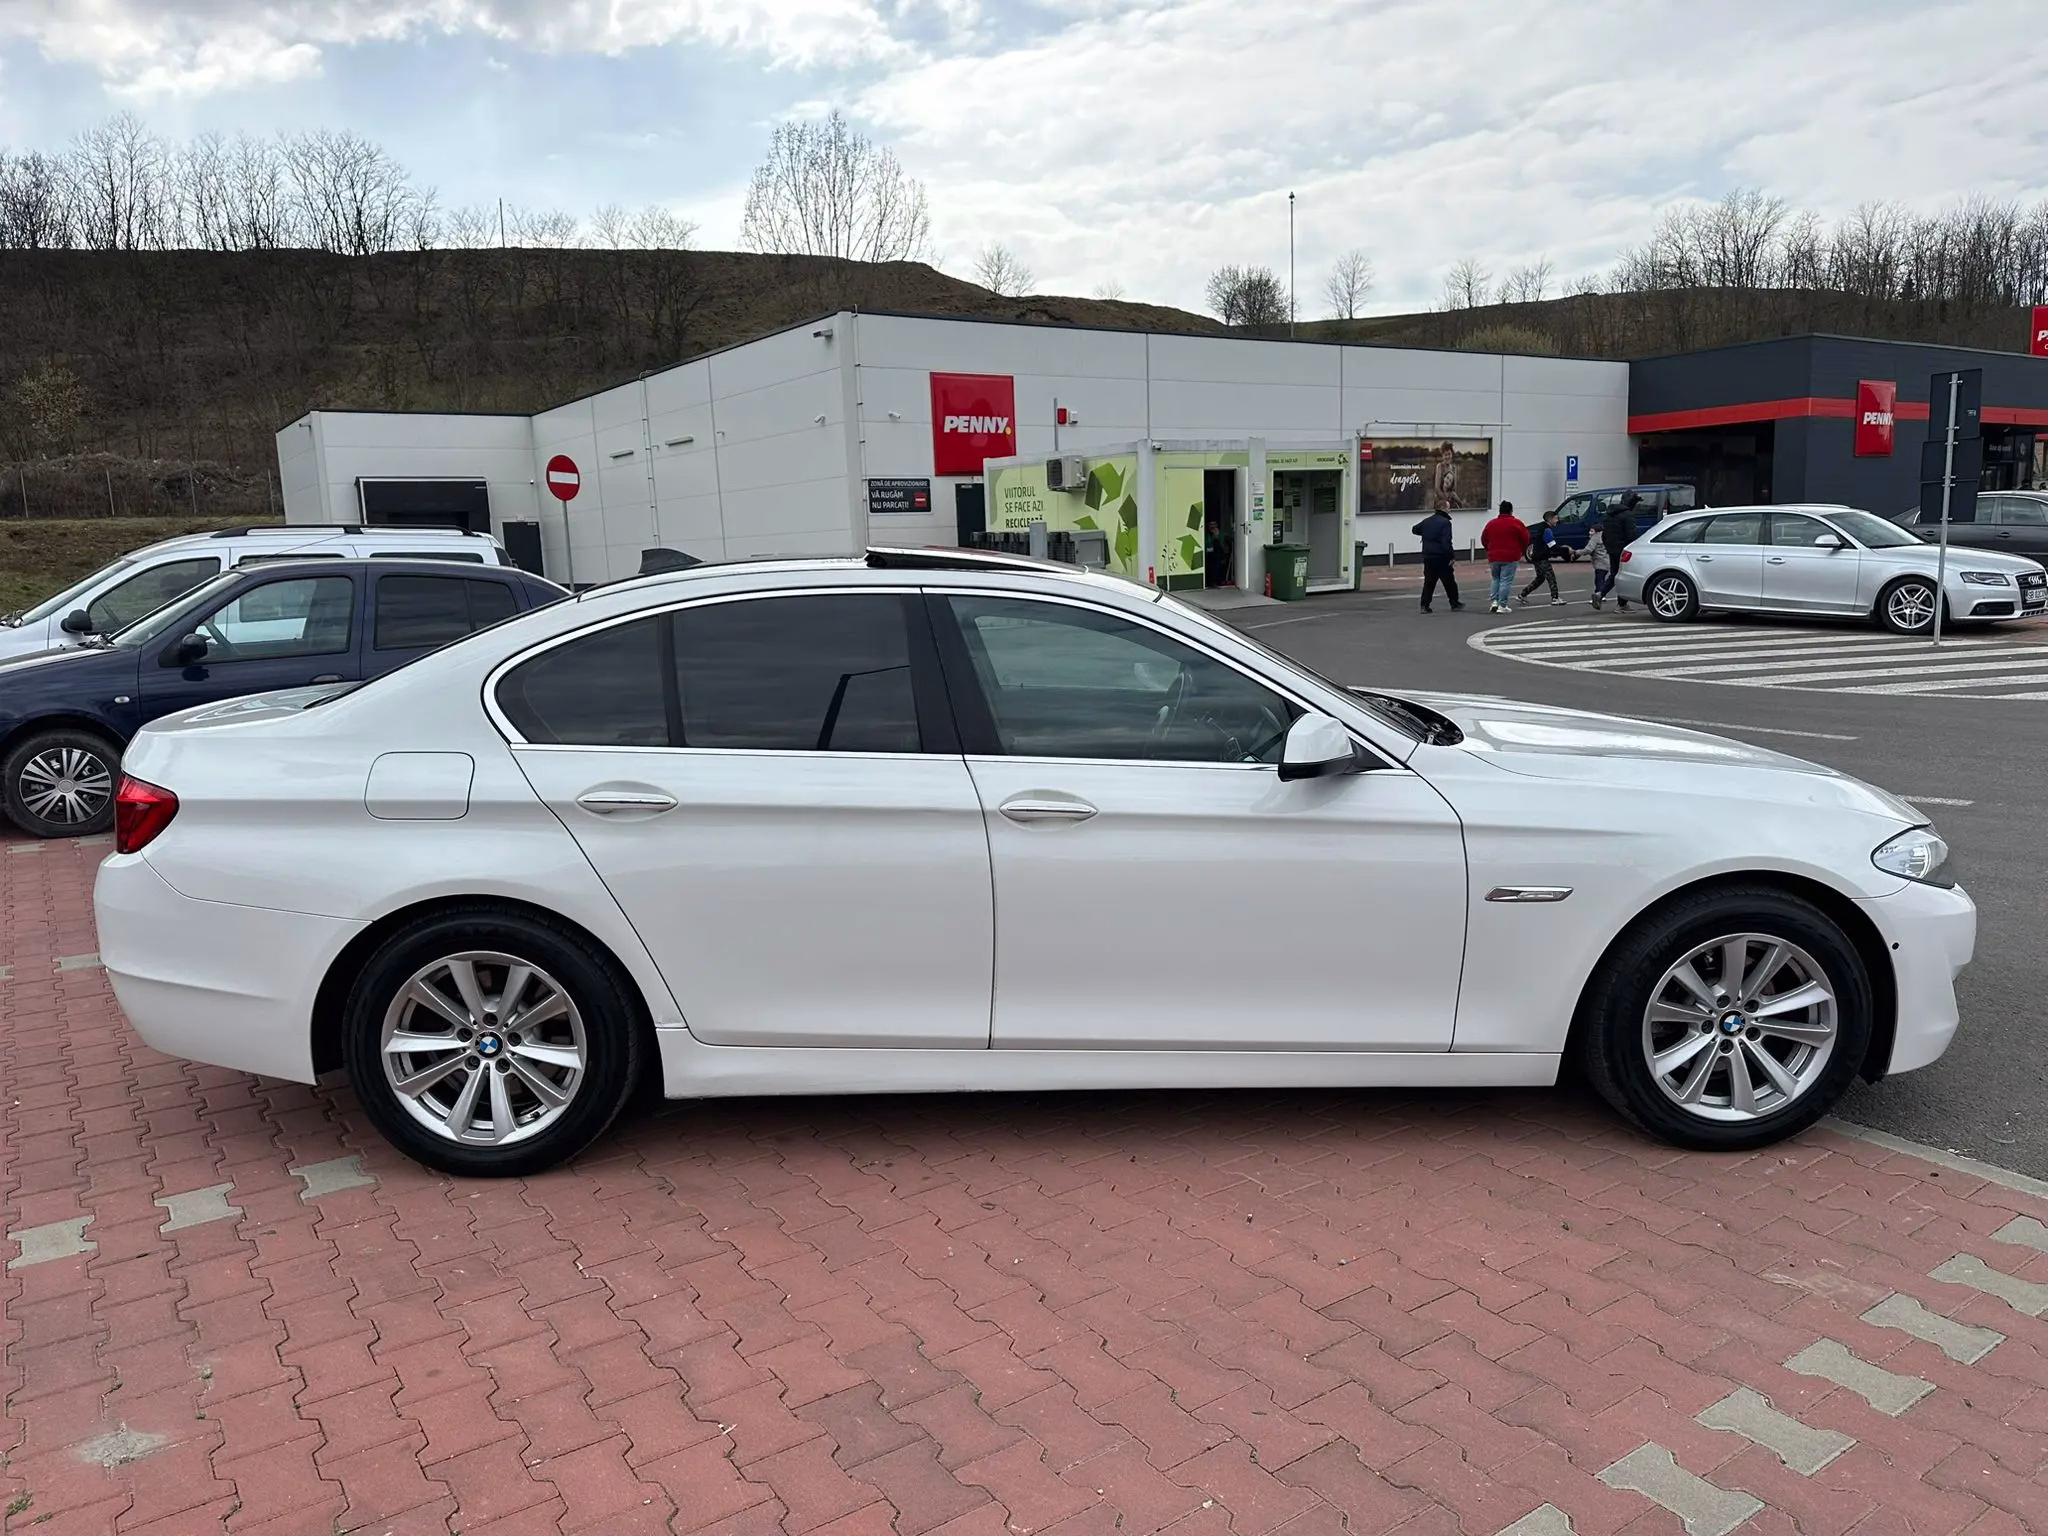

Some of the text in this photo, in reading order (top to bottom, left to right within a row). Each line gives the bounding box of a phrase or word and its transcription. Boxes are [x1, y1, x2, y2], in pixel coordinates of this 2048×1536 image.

[1569, 458, 1577, 473] P
[871, 490, 904, 499] VĂ RUGĂM
[1004, 486, 1036, 498] VIITORUL
[872, 501, 881, 509] NU
[1005, 500, 1044, 513] SE FACE AZI
[1005, 514, 1043, 528] RECICLE
